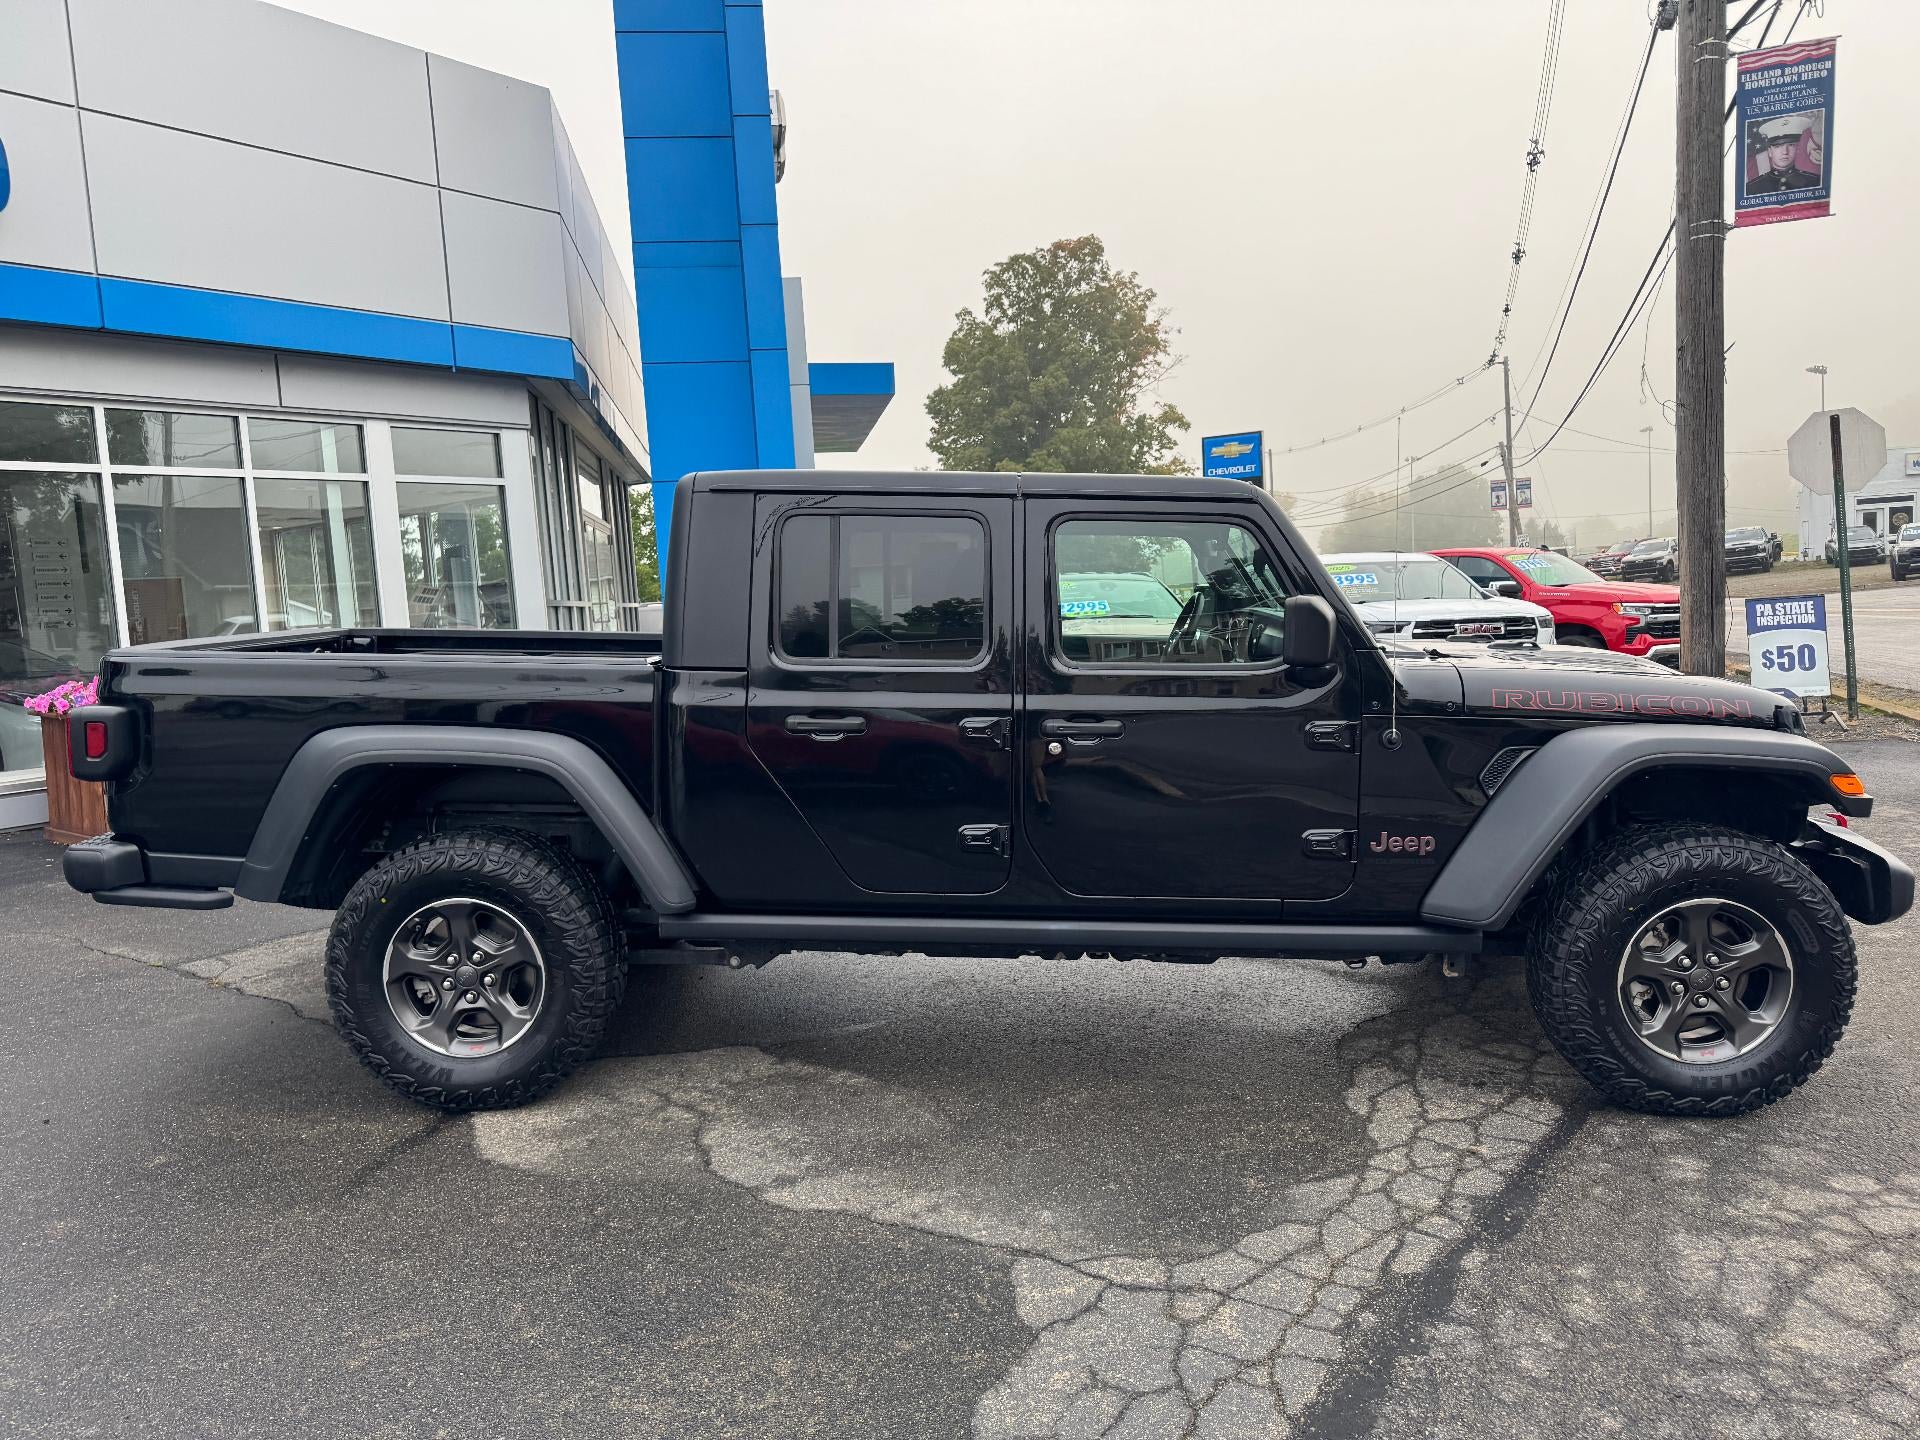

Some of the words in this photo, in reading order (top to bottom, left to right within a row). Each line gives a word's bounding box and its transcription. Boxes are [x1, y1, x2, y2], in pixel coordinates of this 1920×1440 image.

[1741, 69, 1782, 83] ELKLAND
[1784, 60, 1832, 76] BOROUGH
[1744, 74, 1798, 90] HOMETOWN
[1801, 69, 1828, 81] HERO
[1752, 92, 1790, 105] MICHAEL
[1791, 87, 1819, 99] PLANK
[1762, 101, 1796, 113] MARINE
[1796, 96, 1825, 108] CORPS
[1740, 197, 1764, 206] GLOBAL
[1764, 195, 1777, 203] WAR
[1778, 194, 1788, 202] ON
[1207, 464, 1257, 476] CHEVROLET
[1756, 603, 1774, 617] PA
[1775, 600, 1815, 616] STATE
[1756, 613, 1816, 627] INSPECTION
[1459, 624, 1503, 634] GMC
[1761, 643, 1817, 672] $50
[1491, 688, 1752, 718] RUBICON
[1370, 831, 1436, 855] Jeep
